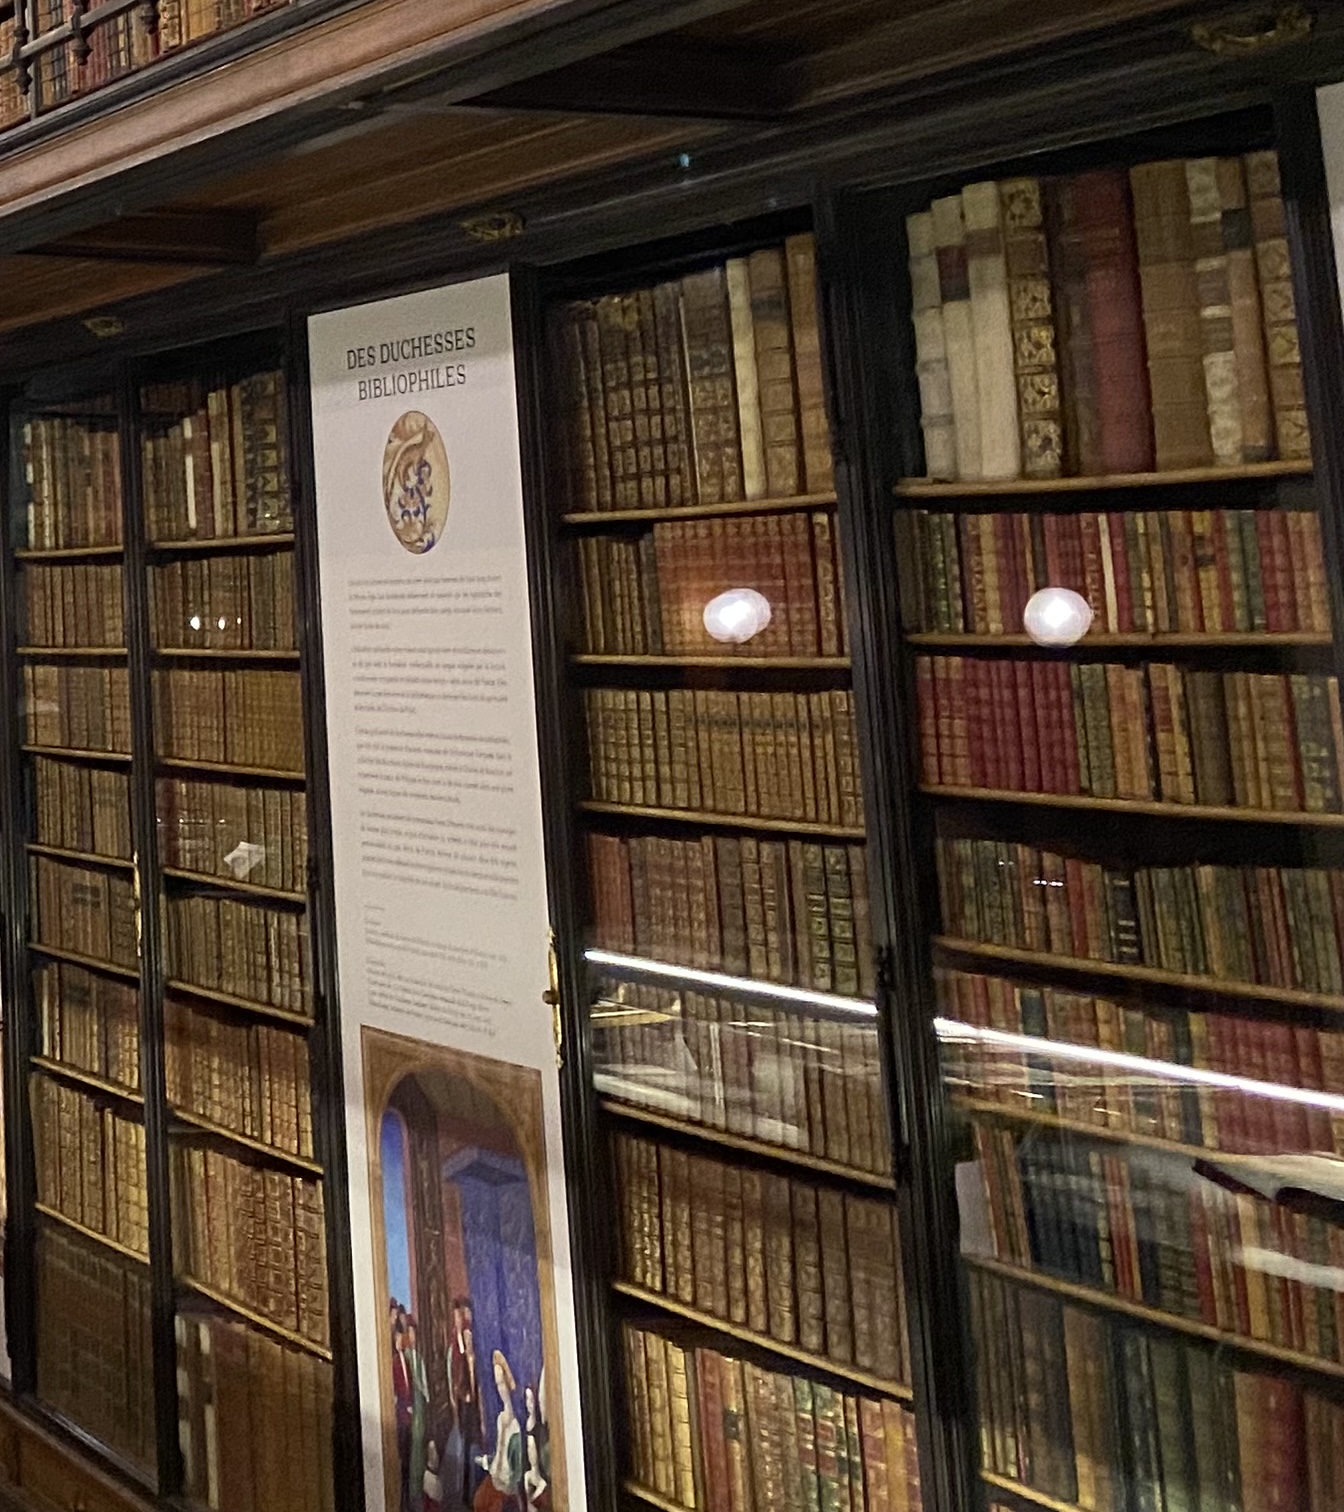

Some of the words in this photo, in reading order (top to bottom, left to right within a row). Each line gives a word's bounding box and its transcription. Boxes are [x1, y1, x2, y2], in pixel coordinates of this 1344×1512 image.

[346, 347, 376, 371] DES
[379, 327, 477, 364] DUCHESSES
[358, 364, 467, 401] BIBLIOPHILES
